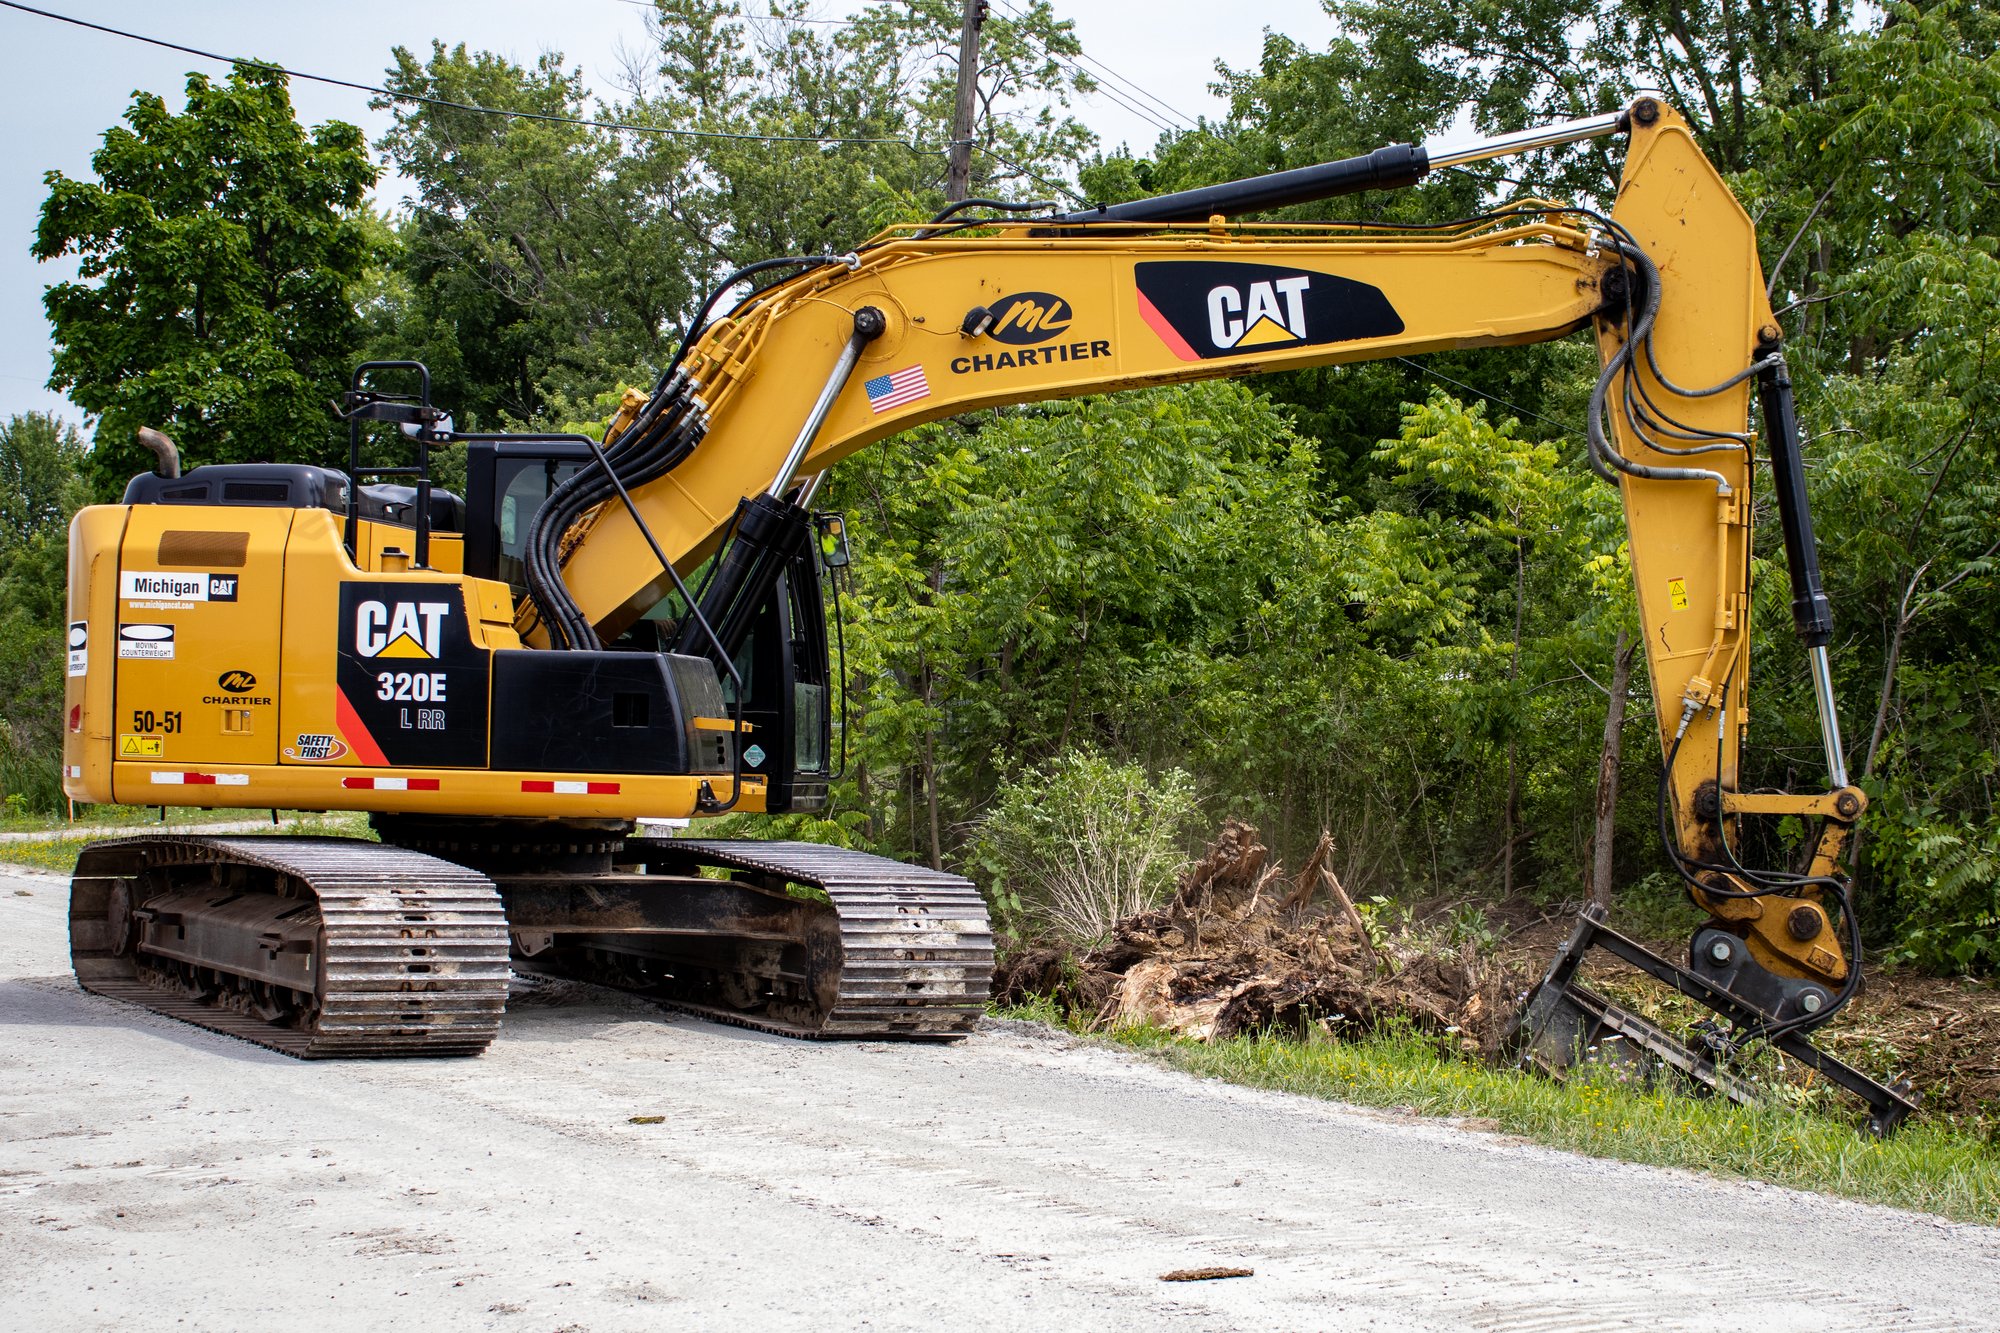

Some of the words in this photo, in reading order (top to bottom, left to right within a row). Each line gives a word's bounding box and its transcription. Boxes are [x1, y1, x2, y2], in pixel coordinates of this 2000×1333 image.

[1207, 276, 1310, 349] CAT
[950, 340, 1112, 375] CHARTIER
[134, 578, 200, 597] Michigan
[210, 579, 238, 596] CAT
[129, 600, 195, 611] www.michigancat.com
[356, 600, 449, 659] CAT
[121, 649, 171, 657] COUNTERWEIGHT
[135, 642, 158, 650] MOVING
[377, 672, 447, 702] 320E
[202, 696, 272, 705] CHARTIER
[133, 710, 182, 733] 50-51
[401, 708, 412, 729] L
[418, 709, 445, 730] RR
[298, 734, 334, 747] SAFETY
[301, 746, 331, 758] FIRST
